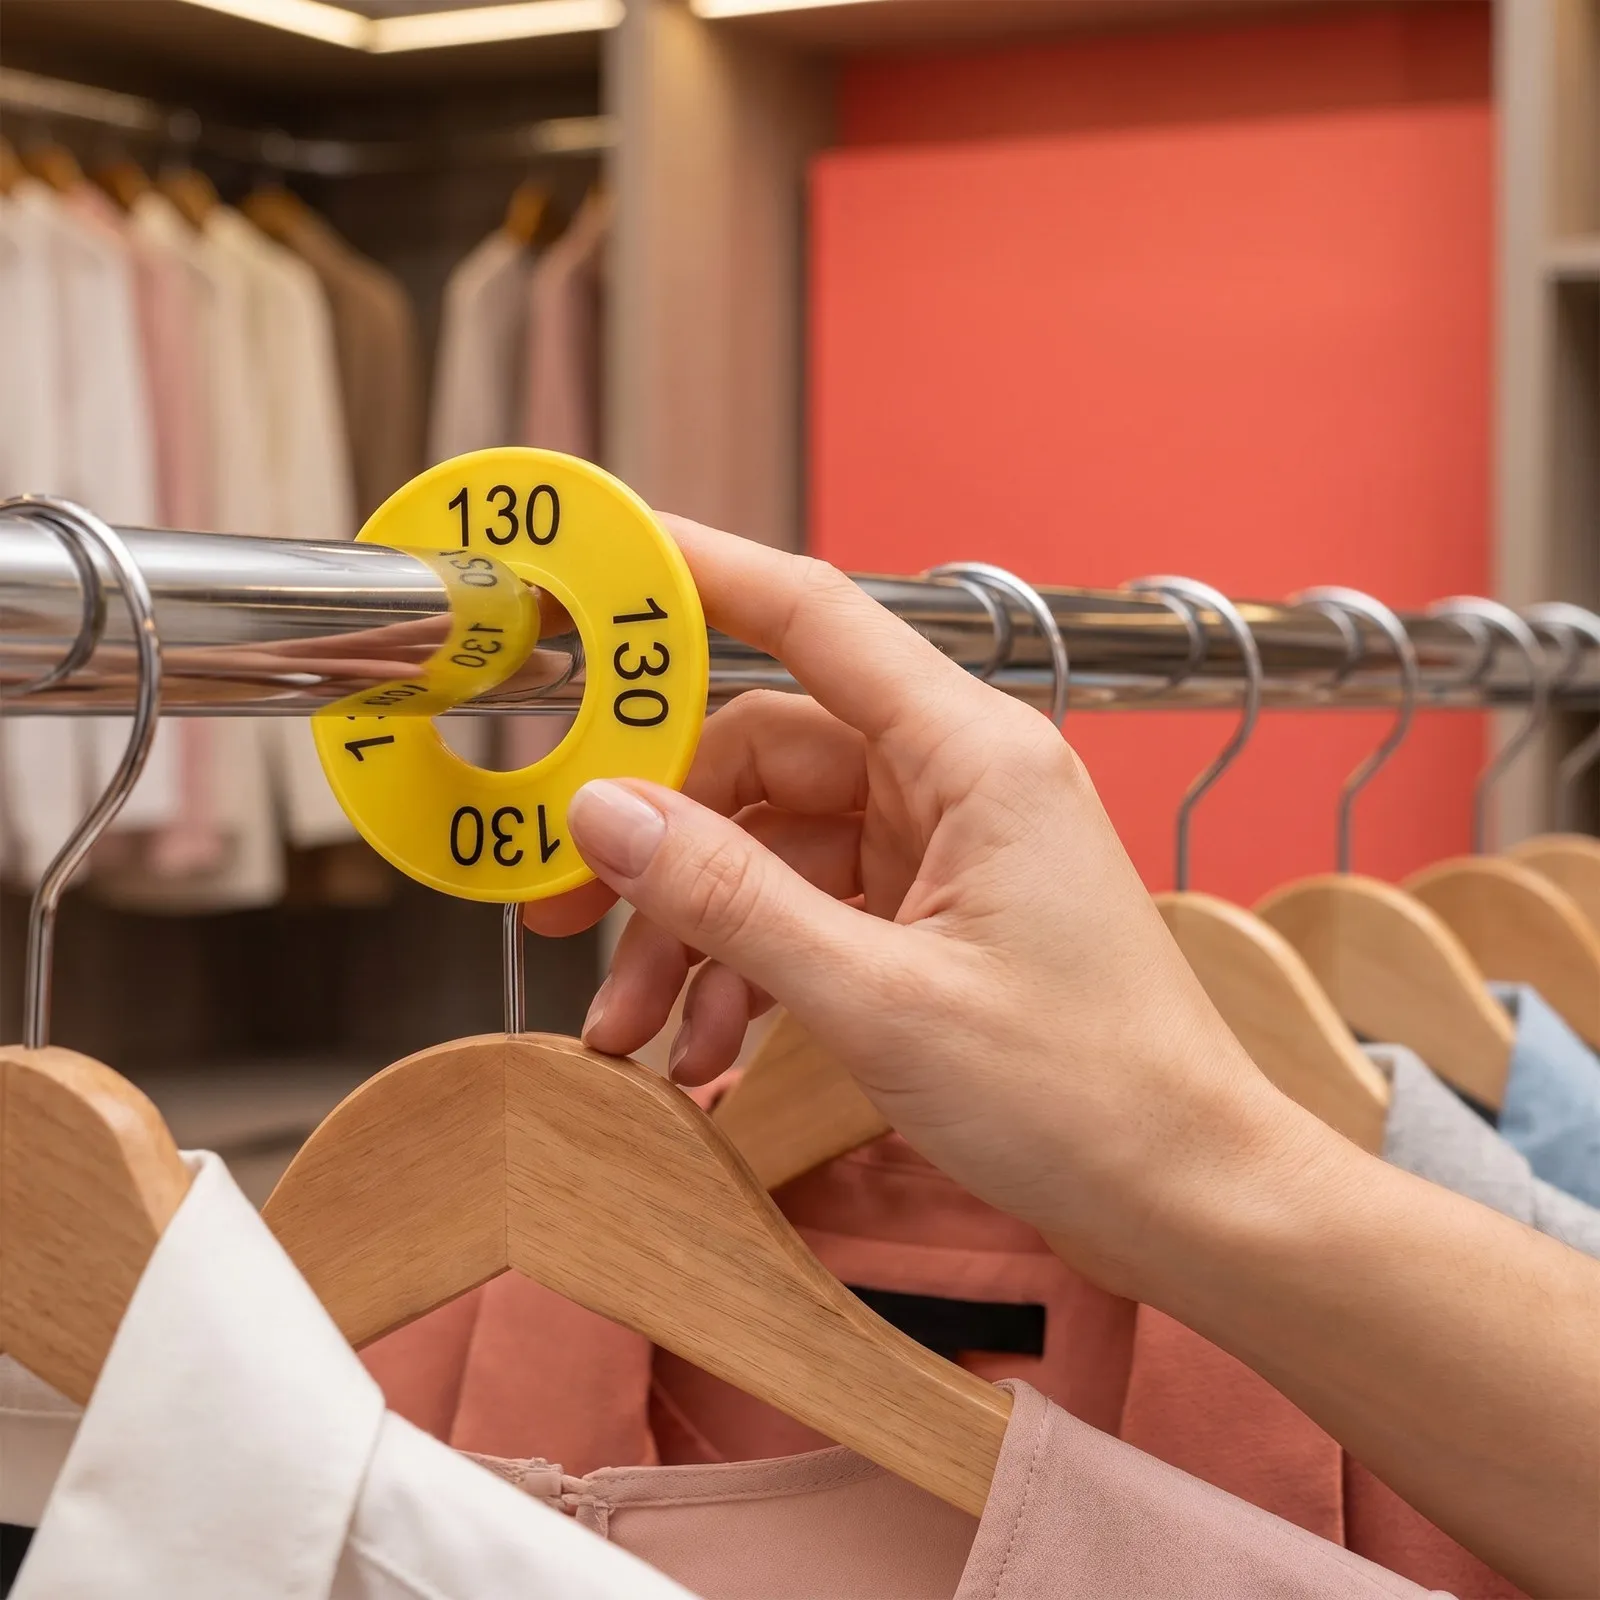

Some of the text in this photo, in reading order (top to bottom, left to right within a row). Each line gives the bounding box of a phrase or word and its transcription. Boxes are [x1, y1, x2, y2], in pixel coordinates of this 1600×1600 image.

[448, 484, 560, 547] 130
[613, 597, 670, 727] 130
[450, 804, 561, 867] 130
